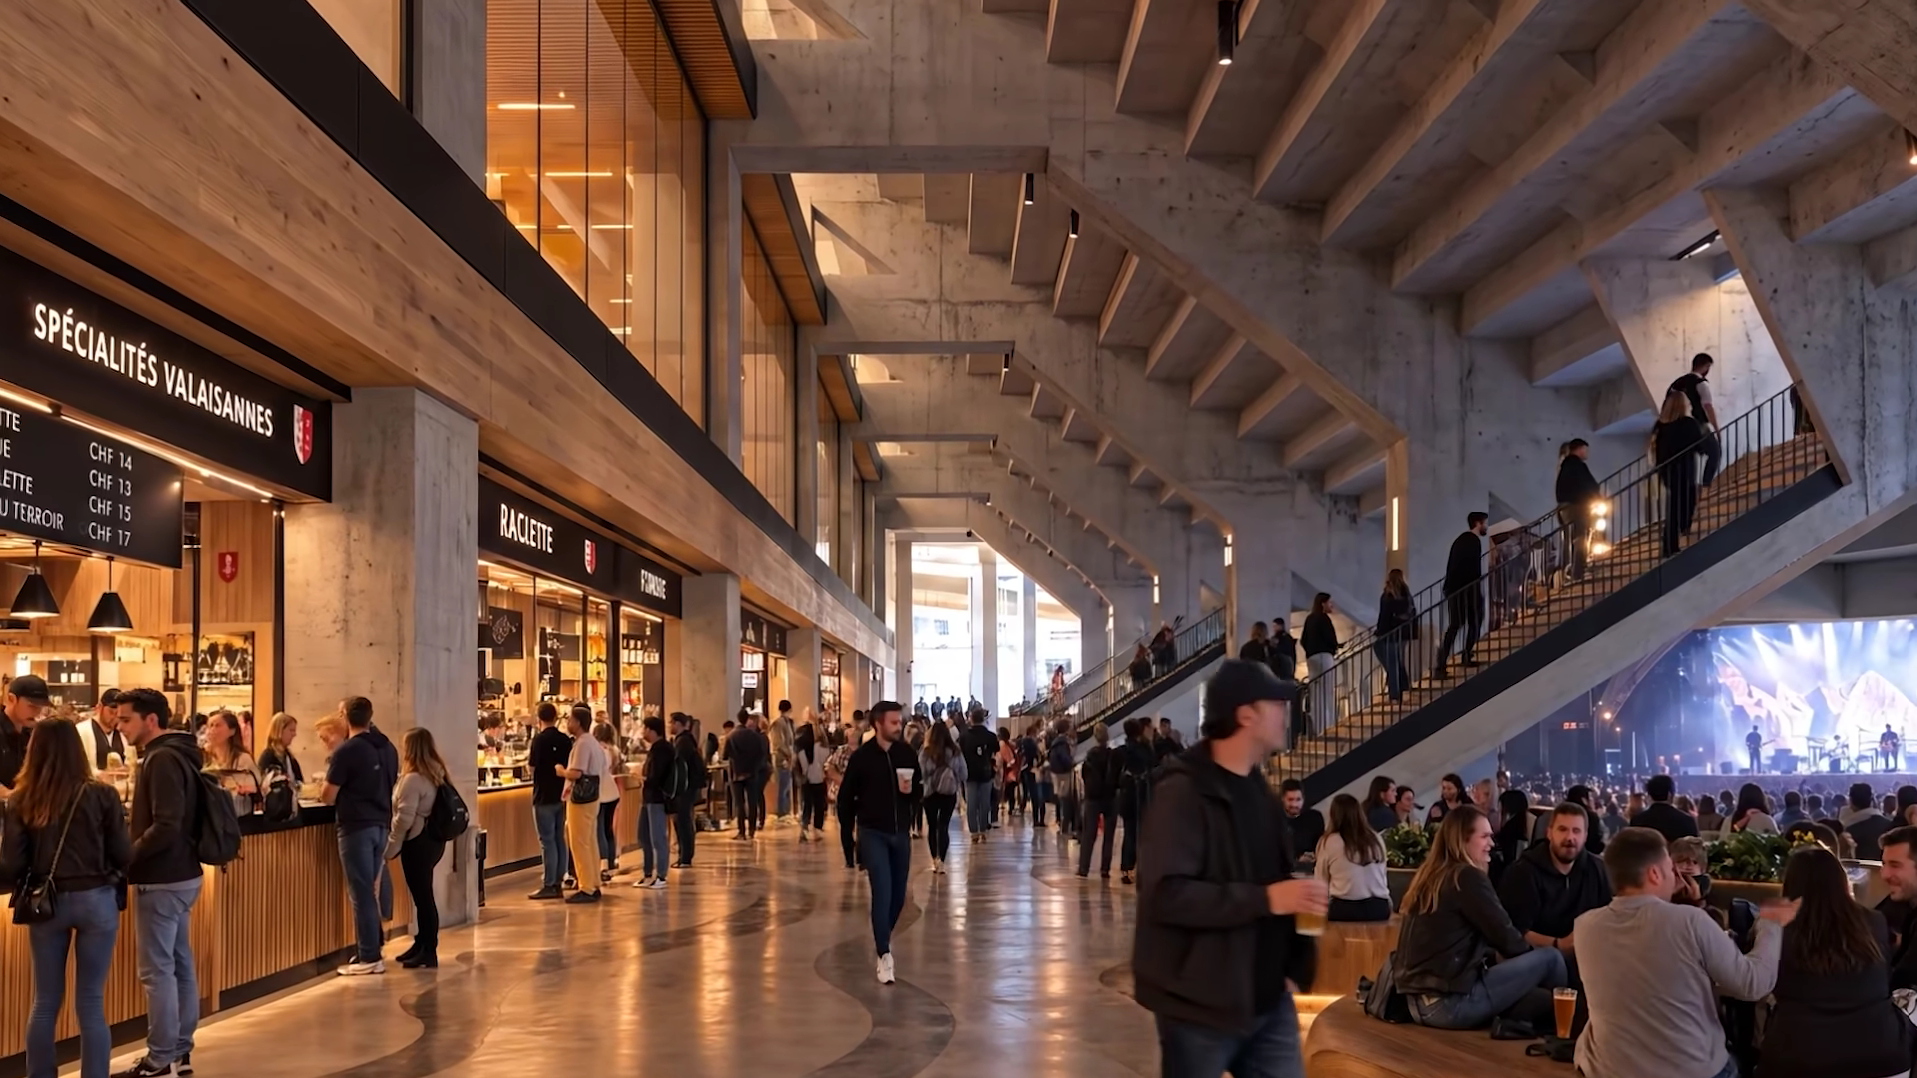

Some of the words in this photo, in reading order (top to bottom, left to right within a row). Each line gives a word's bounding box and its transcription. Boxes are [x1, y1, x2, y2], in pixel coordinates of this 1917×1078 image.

[34, 302, 158, 387] SPÉCIALITÉS
[163, 361, 274, 437] VALAISANNES
[89, 442, 114, 465] CHF
[119, 452, 133, 471] 14
[0, 469, 33, 495] ETTE
[89, 495, 113, 517] CHF
[118, 503, 132, 522] 15
[89, 469, 113, 491] CHF
[118, 478, 132, 497] 13
[13, 501, 64, 531] TERROIR
[88, 522, 112, 543] CHF
[117, 529, 132, 547] 17
[500, 503, 553, 554] RACLETTE
